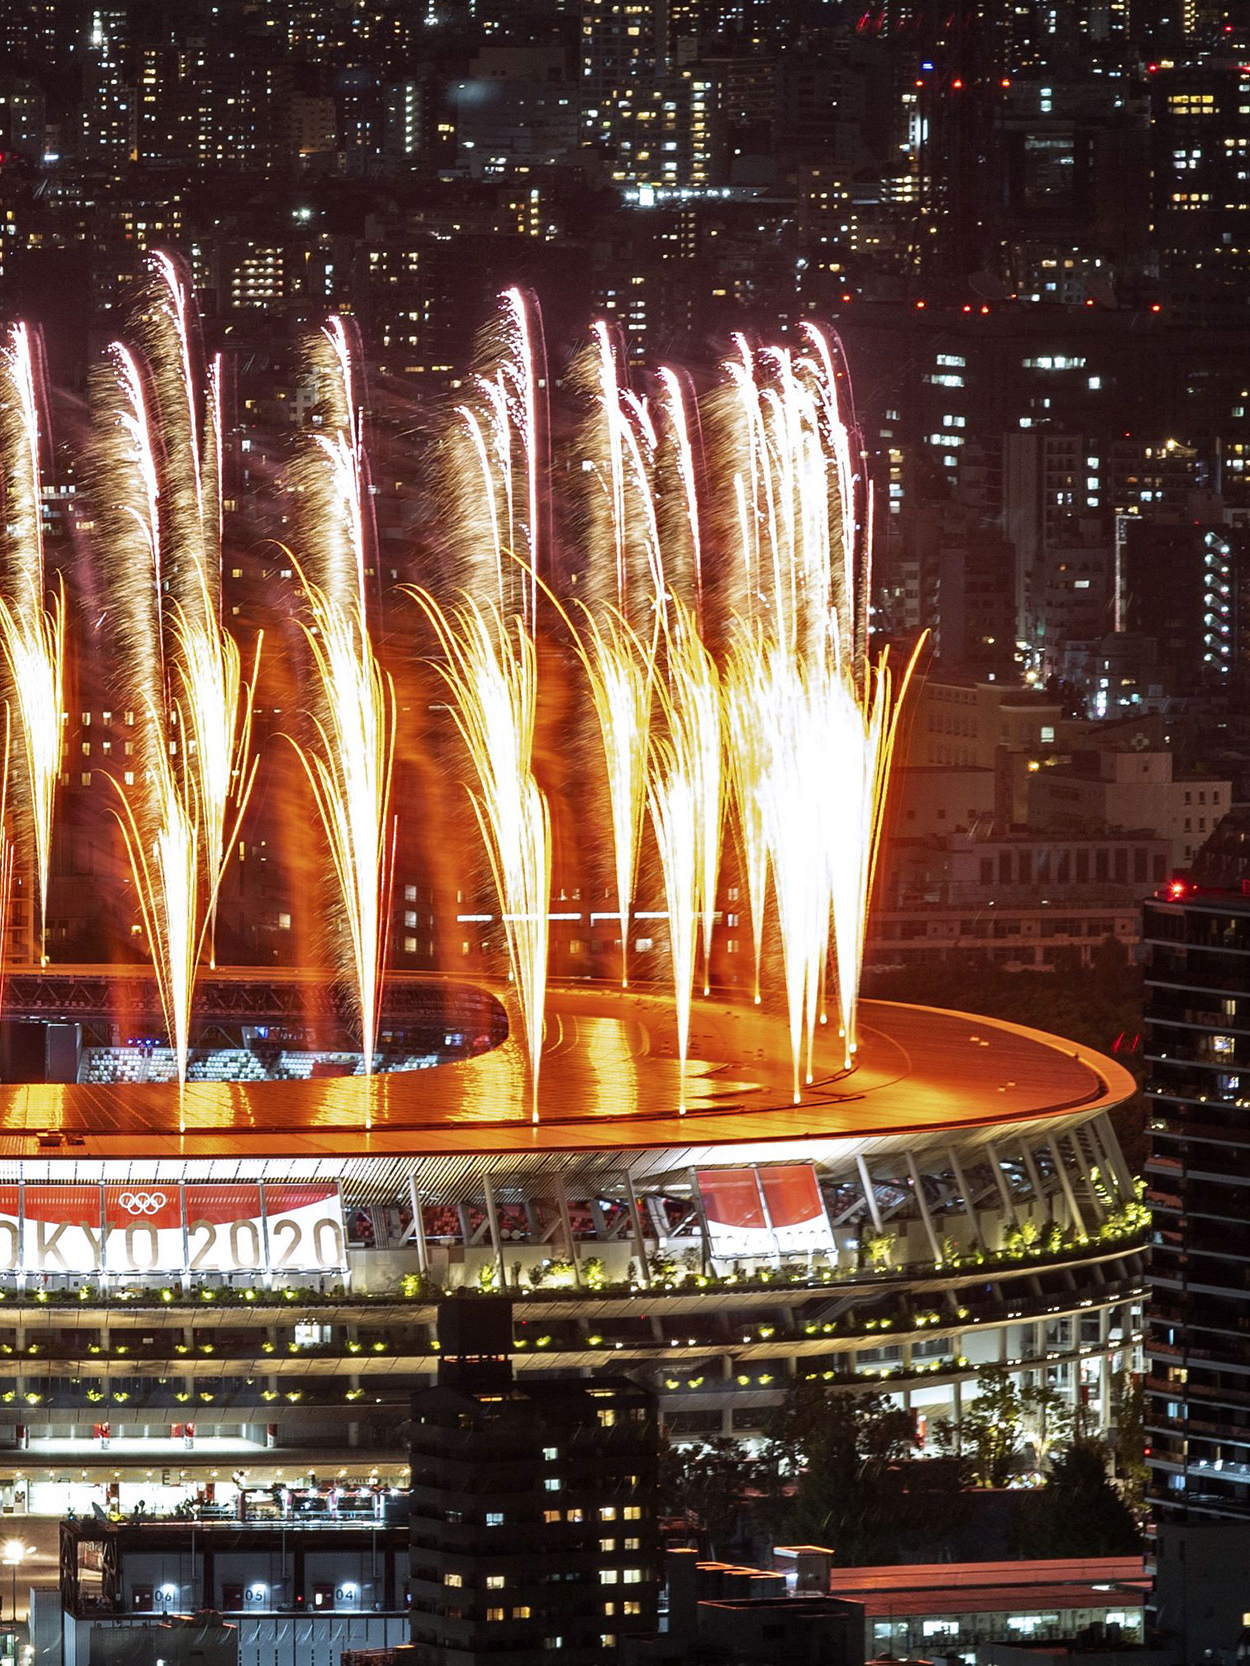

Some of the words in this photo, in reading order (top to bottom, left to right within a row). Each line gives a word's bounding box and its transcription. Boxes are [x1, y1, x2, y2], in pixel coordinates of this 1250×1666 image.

[188, 1218, 343, 1269] 2020
[154, 1590, 172, 1601] 06
[245, 1589, 263, 1601] 05
[335, 1589, 353, 1601] 04
